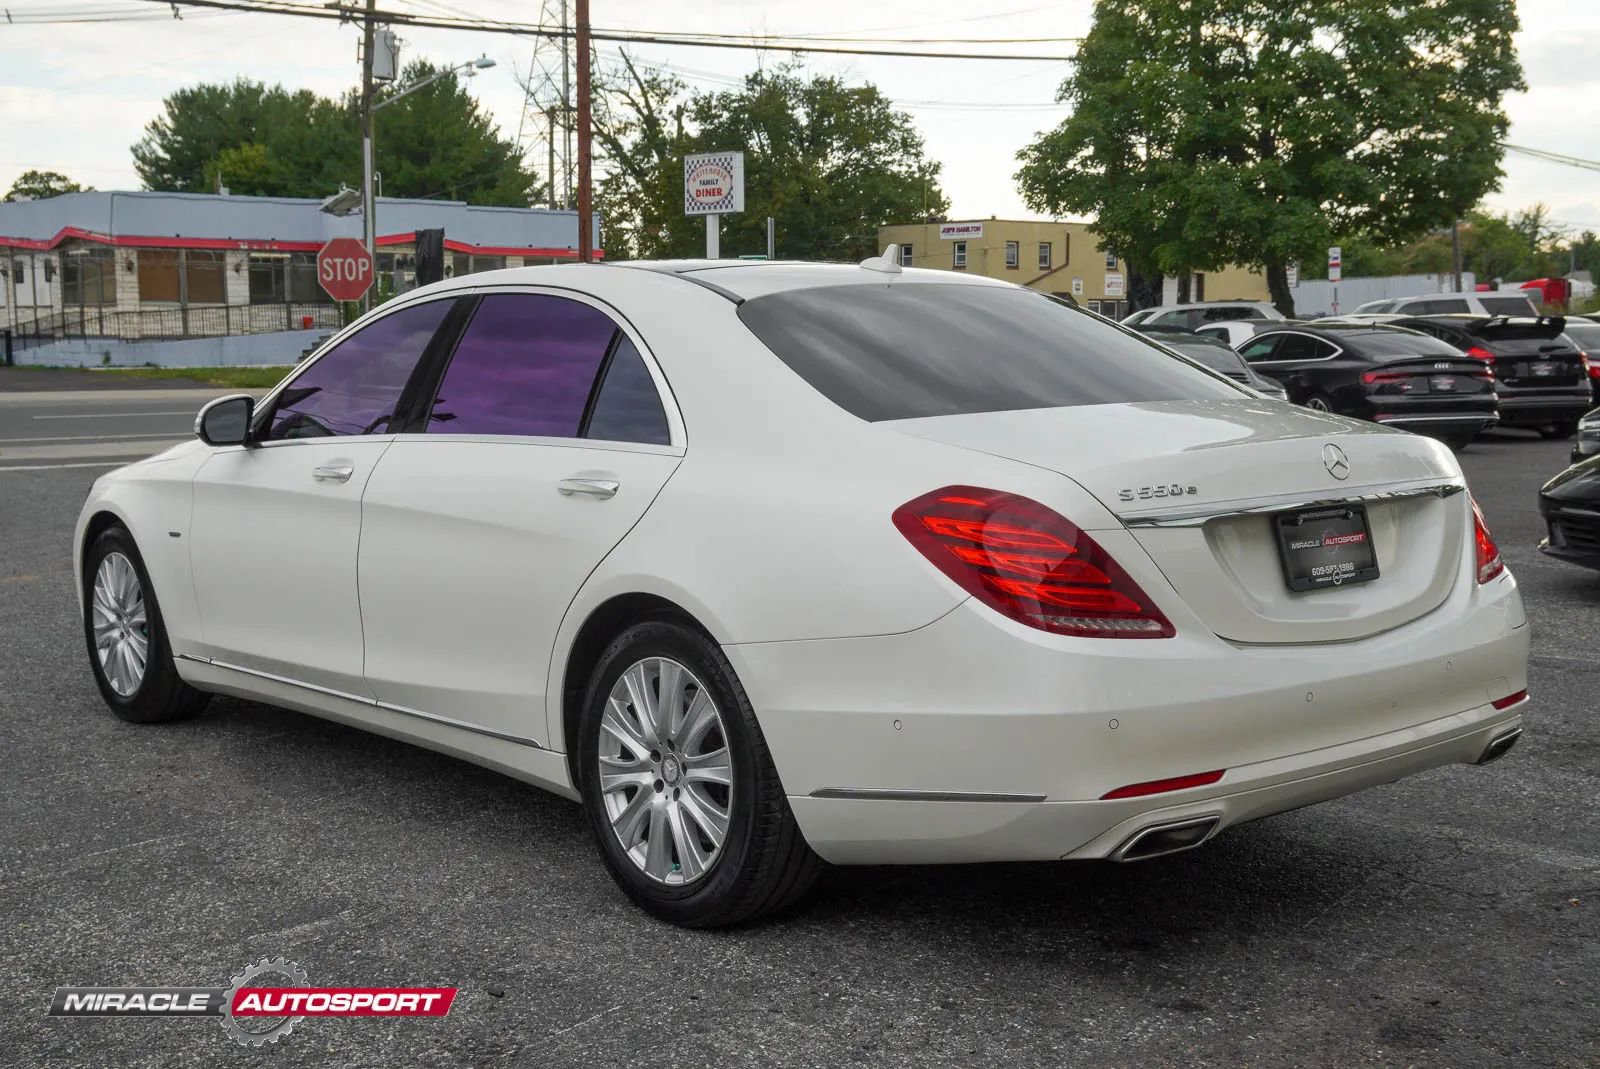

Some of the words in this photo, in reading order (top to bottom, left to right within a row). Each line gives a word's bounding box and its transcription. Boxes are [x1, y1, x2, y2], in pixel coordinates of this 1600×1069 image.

[699, 178, 719, 186] FAMILY
[695, 188, 723, 198] DINER
[321, 257, 370, 281] STOP
[1118, 489, 1135, 502] S
[1291, 540, 1321, 551] MIRACLE
[1325, 534, 1364, 546] AUTOSPORT
